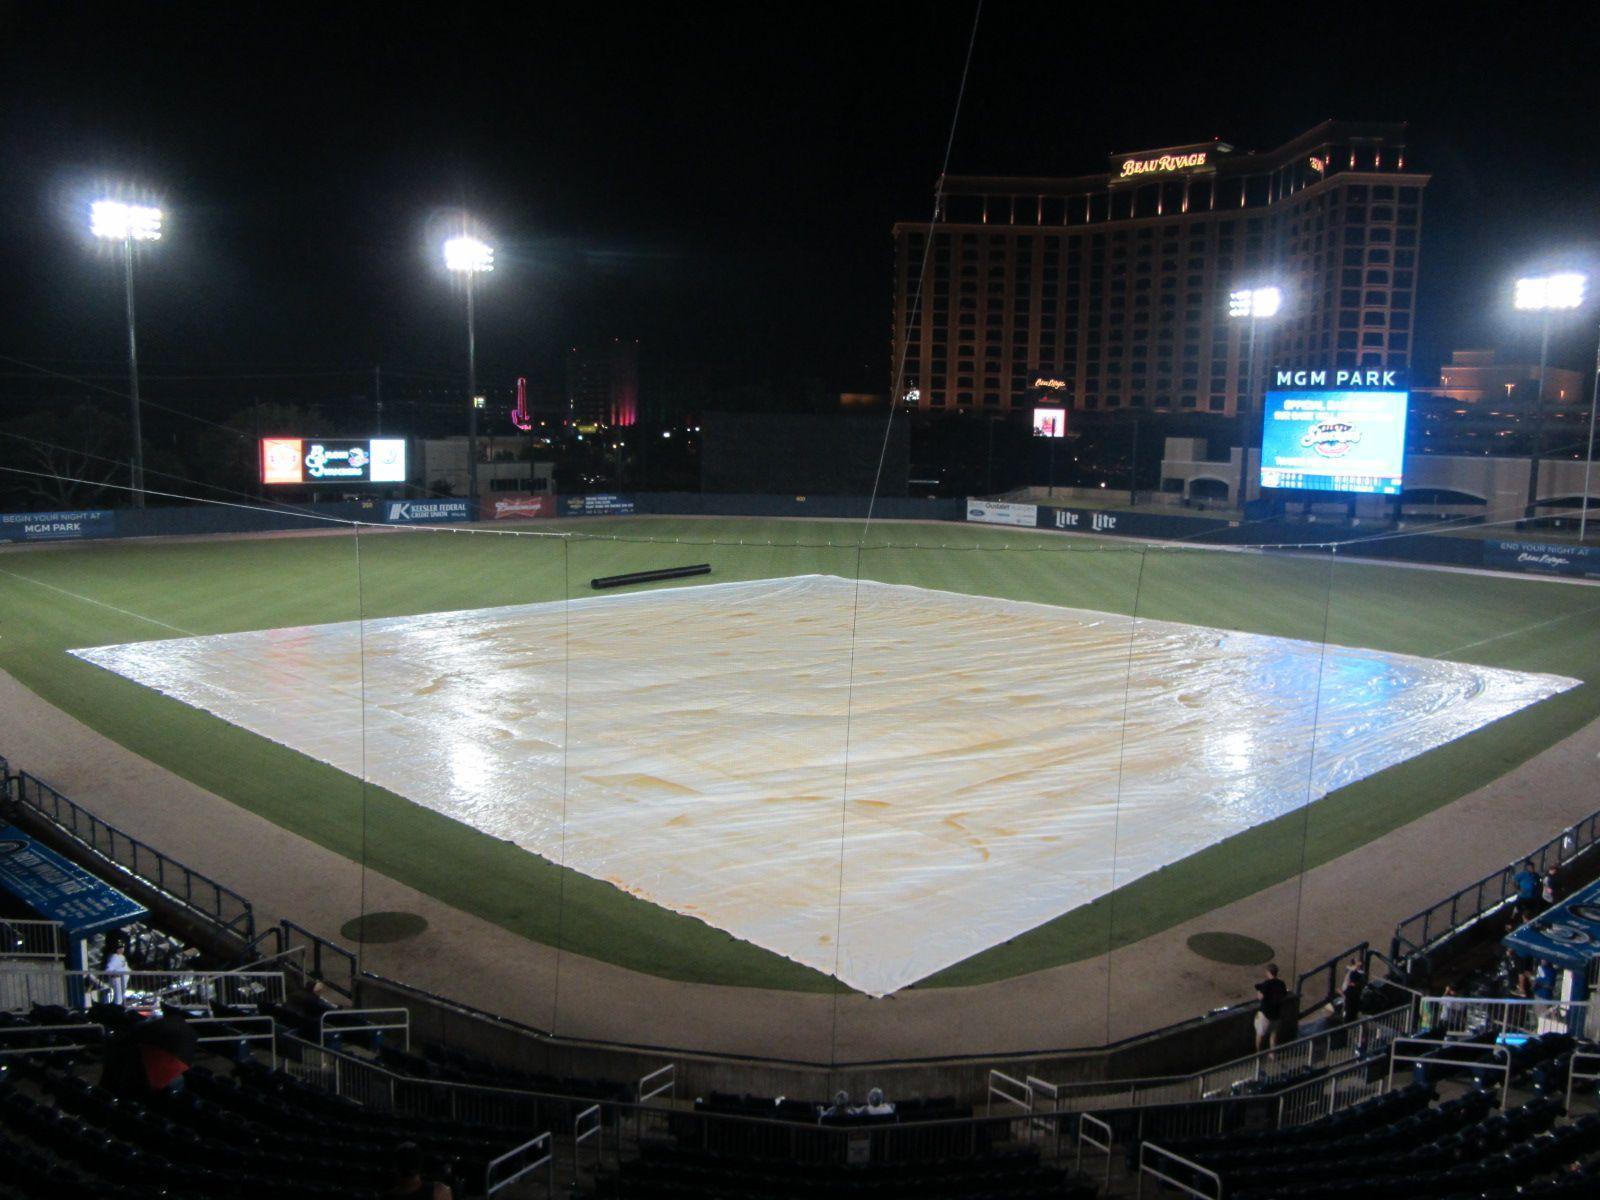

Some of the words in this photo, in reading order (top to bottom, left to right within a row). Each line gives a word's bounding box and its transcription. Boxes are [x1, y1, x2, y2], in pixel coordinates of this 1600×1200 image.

[1120, 158, 1158, 178] BEAU
[1158, 152, 1207, 172] RIVAGE
[1276, 370, 1327, 386] MGM
[1336, 370, 1397, 386] PARK
[411, 504, 438, 512] KEESLER
[439, 503, 466, 511] FEDERAL
[3, 514, 31, 522] BEGIN
[61, 513, 87, 521] NIGHT
[1056, 510, 1080, 528] Lite
[1092, 512, 1117, 532] Lite
[24, 524, 50, 532] MGM
[53, 523, 81, 531] PARK
[1500, 542, 1519, 550] END
[1521, 543, 1546, 552] YOUR
[1547, 546, 1575, 555] NIGHT
[1578, 548, 1590, 556] AT
